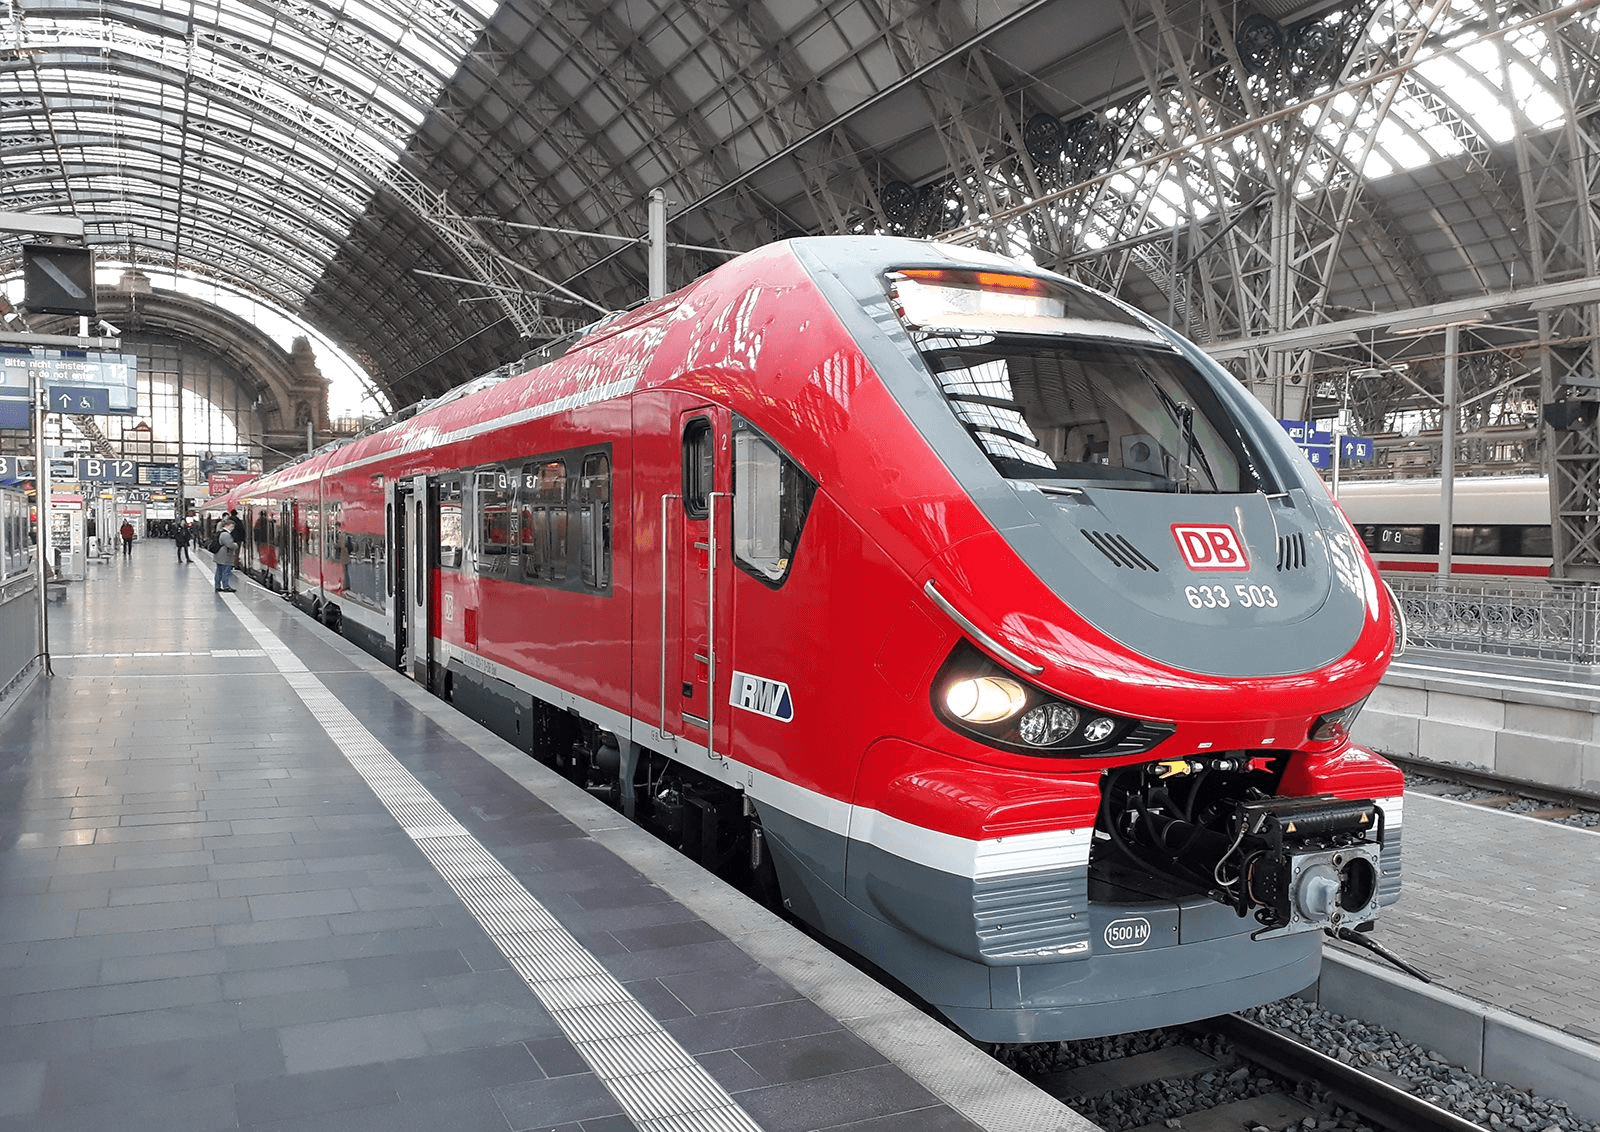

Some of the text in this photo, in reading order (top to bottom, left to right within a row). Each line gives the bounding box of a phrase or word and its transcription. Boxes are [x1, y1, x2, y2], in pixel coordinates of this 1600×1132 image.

[4, 358, 26, 367] Bitte
[29, 360, 52, 369] nicht
[38, 370, 50, 378] do
[53, 371, 68, 379] not
[721, 433, 727, 451] 2
[111, 460, 133, 477] 12
[140, 492, 150, 501] 12
[1180, 531, 1238, 564] DB
[1184, 584, 1279, 609] 633 503
[740, 676, 786, 716] RMV
[1108, 924, 1147, 942] 1500 kN
